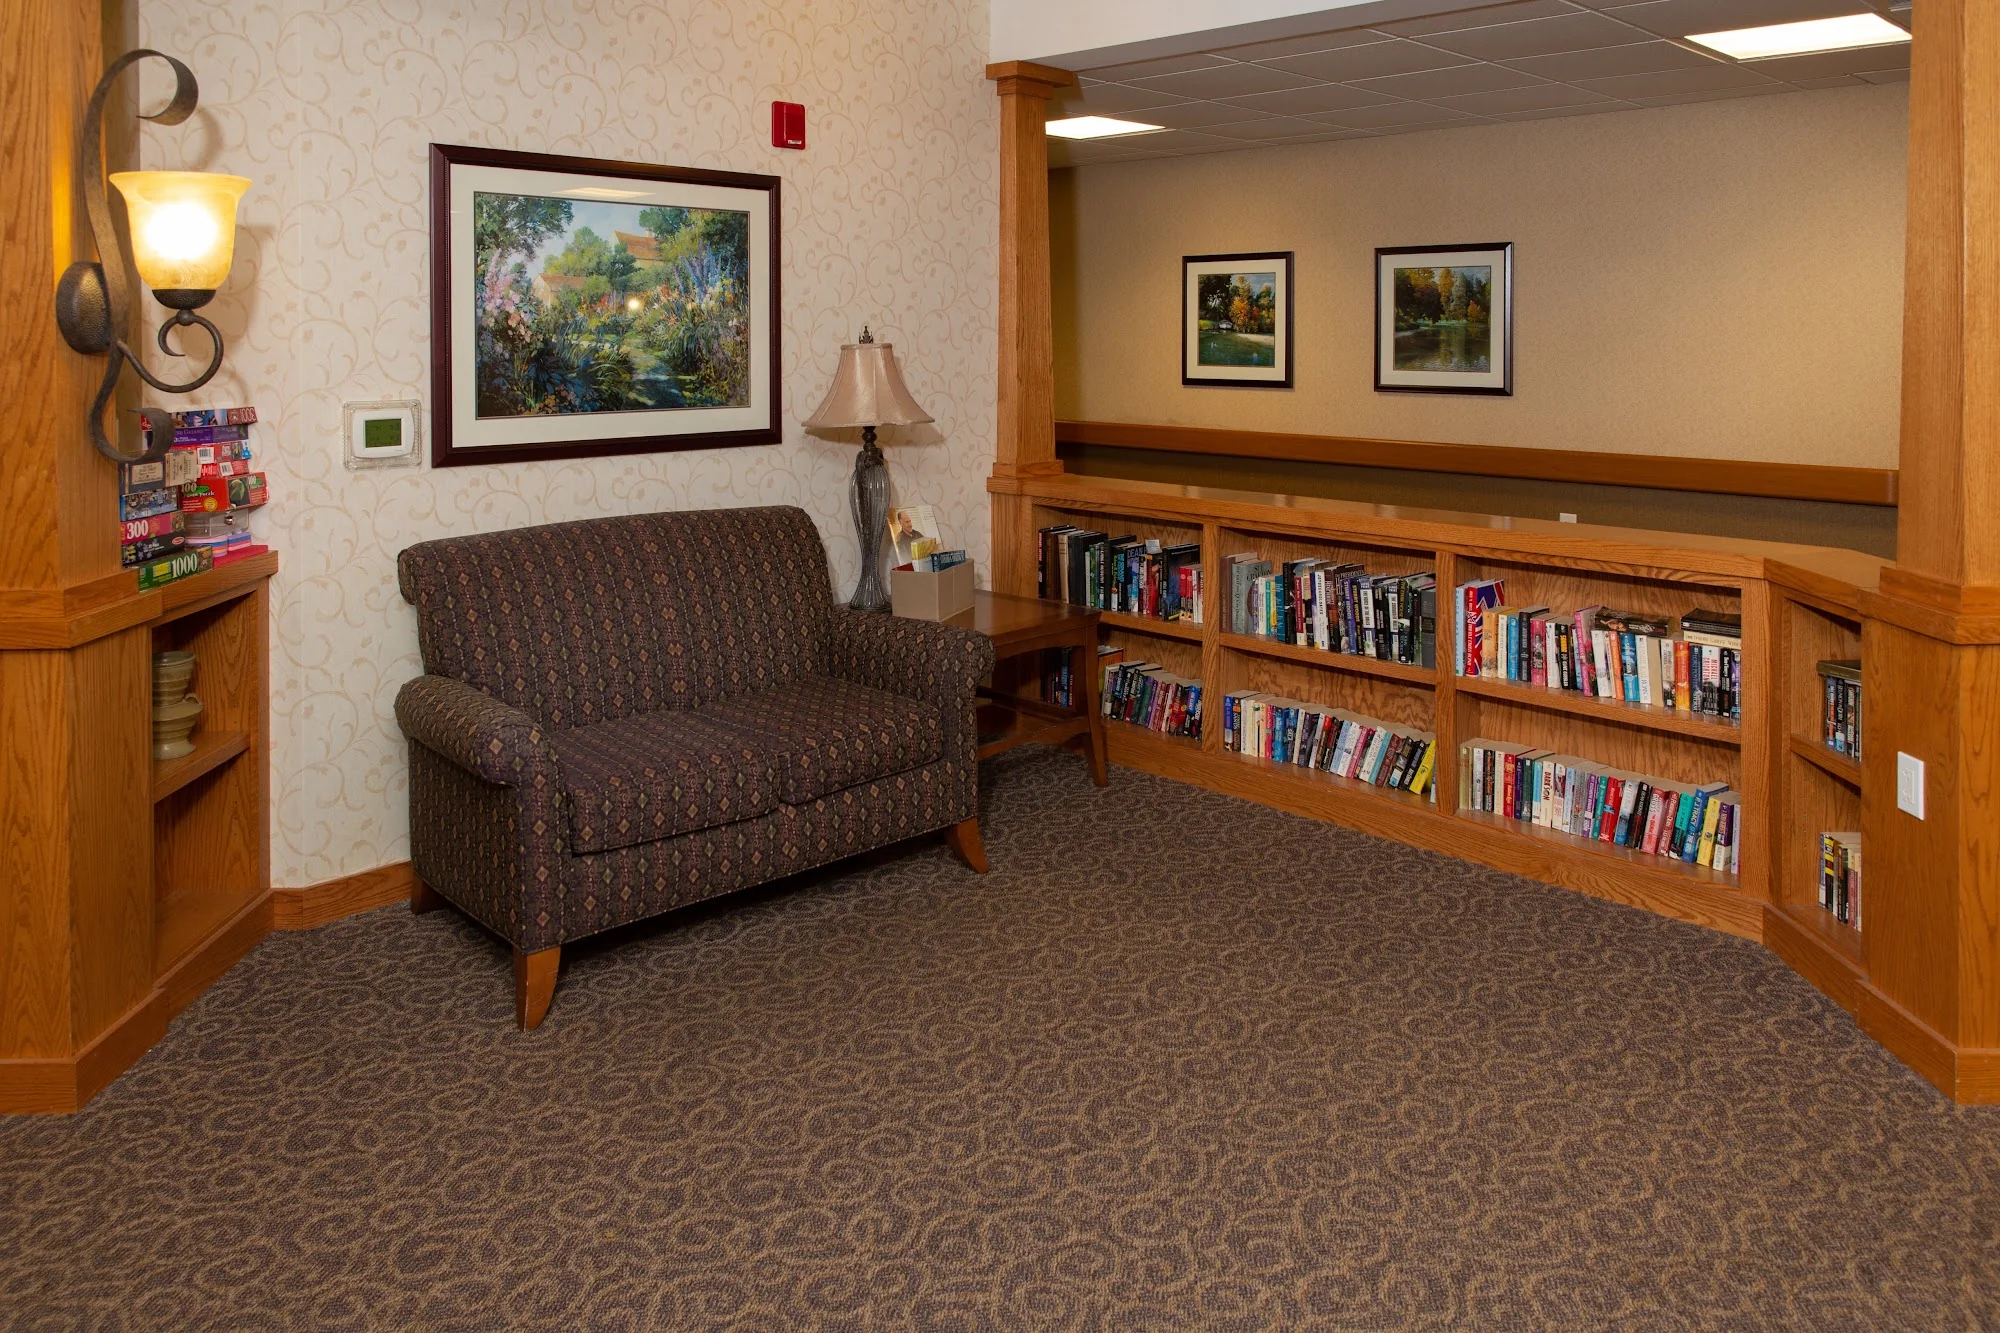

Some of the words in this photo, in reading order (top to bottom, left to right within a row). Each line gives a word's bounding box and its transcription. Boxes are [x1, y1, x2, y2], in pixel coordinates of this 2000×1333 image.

[126, 519, 149, 540] 300
[171, 553, 198, 579] 1000
[1543, 772, 1552, 787] DARK
[1691, 807, 1699, 825] TRACY
